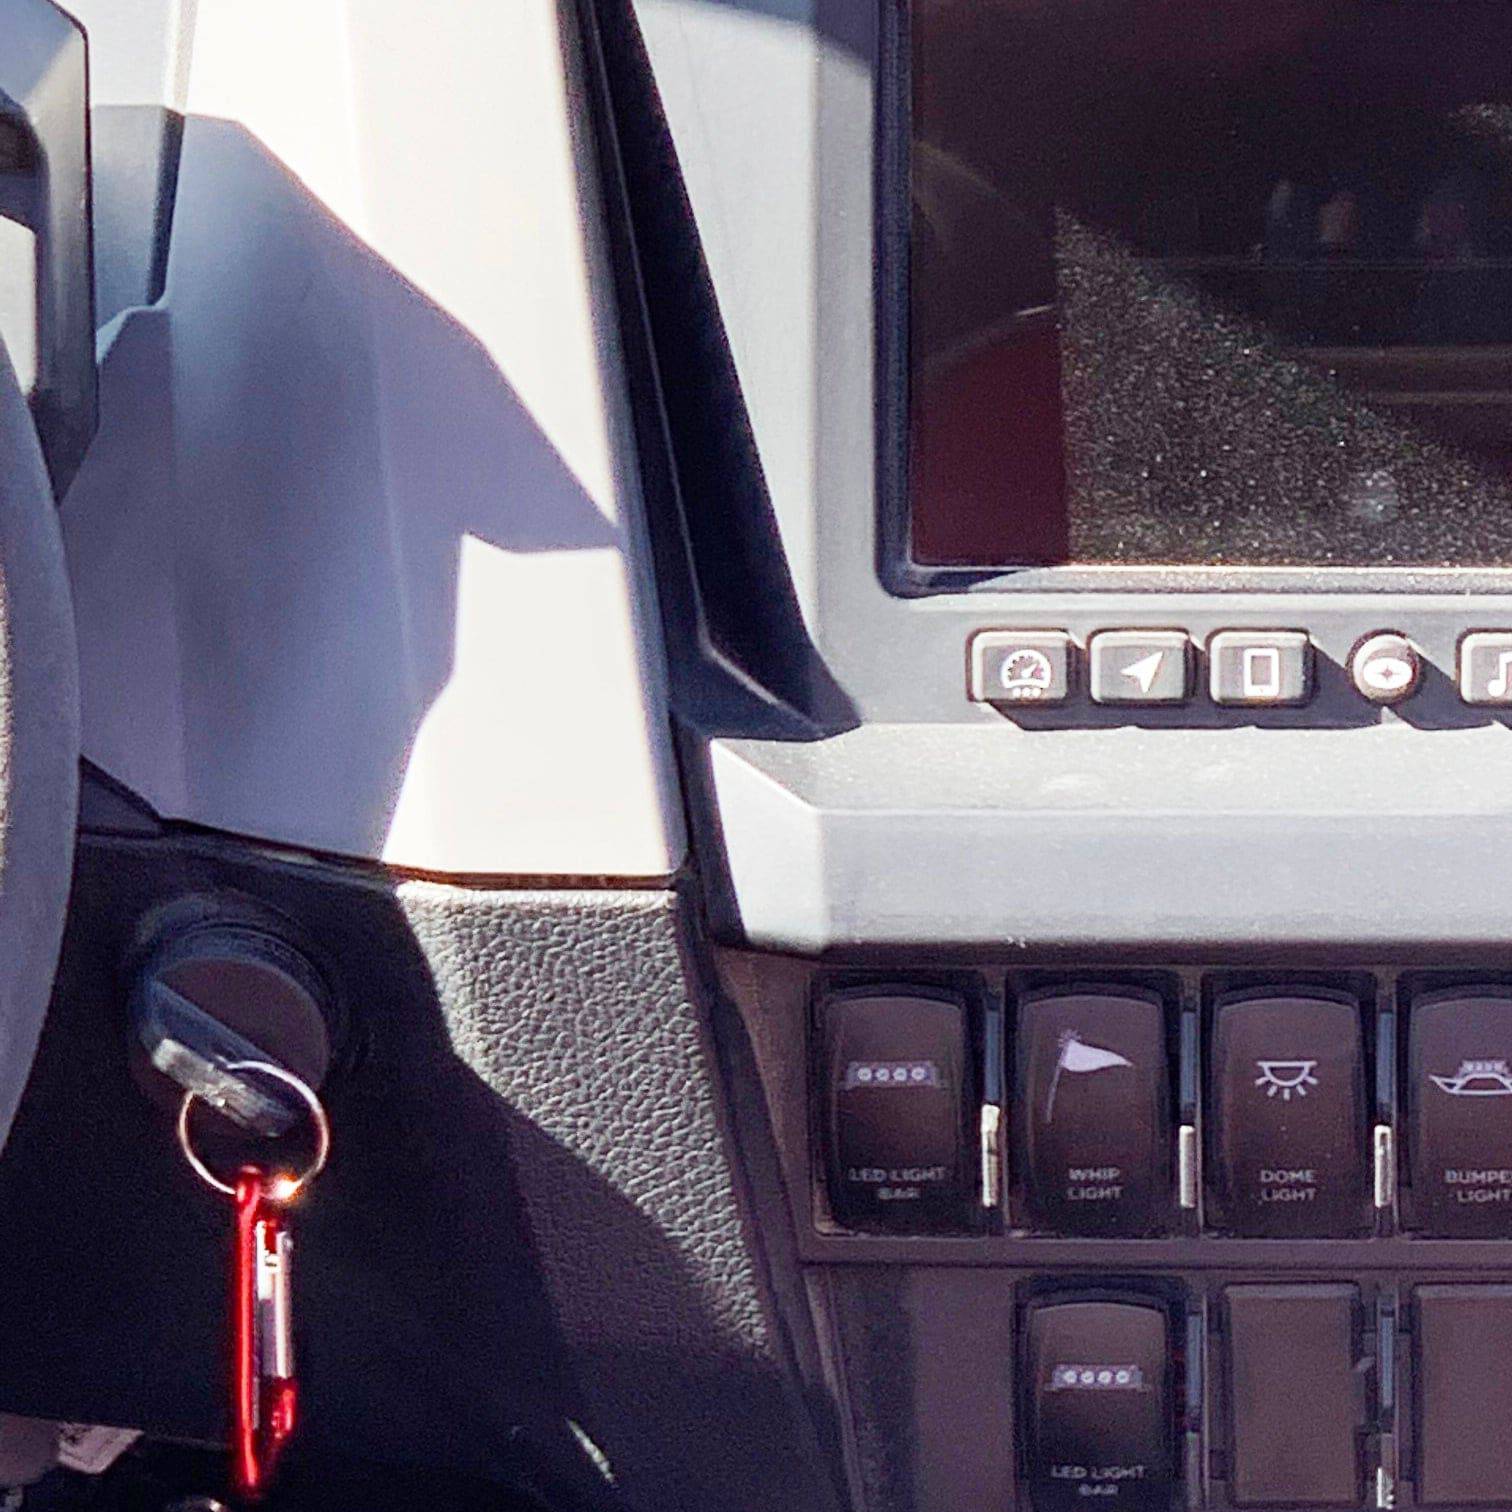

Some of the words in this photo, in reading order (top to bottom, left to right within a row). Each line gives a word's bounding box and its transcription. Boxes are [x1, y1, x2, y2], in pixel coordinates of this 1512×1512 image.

[848, 1167, 887, 1182] LED
[889, 1167, 945, 1182] LIGHT
[1069, 1167, 1120, 1181] WHIP
[1261, 1169, 1317, 1183] DOME
[1067, 1187, 1122, 1200] LIGHT
[1261, 1188, 1316, 1201] LIGHT
[1457, 1189, 1511, 1202] LIGHT
[1051, 1465, 1087, 1479] LED
[1090, 1465, 1144, 1479] LIGHT
